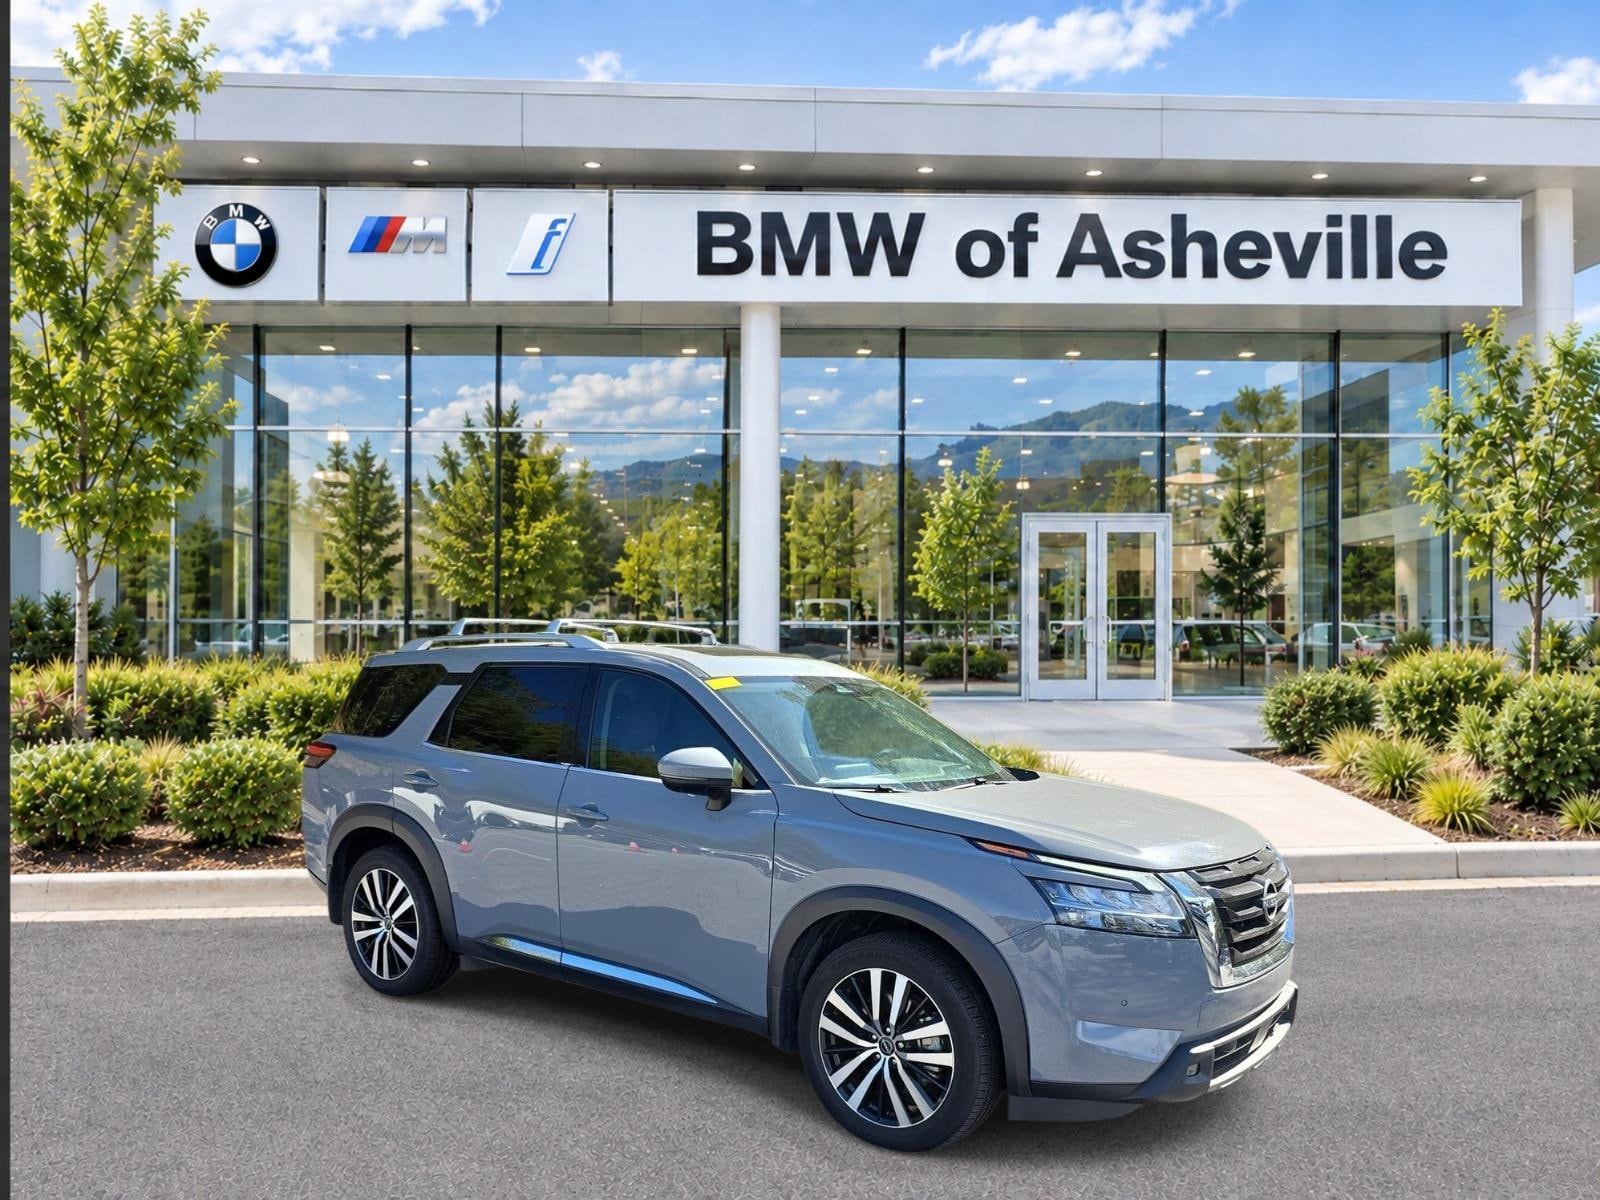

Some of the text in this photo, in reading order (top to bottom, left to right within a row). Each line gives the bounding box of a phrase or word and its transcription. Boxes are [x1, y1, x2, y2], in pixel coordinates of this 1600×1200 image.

[203, 204, 271, 230] BMW
[389, 216, 448, 254] M
[697, 210, 1448, 280] BMW of Asheville
